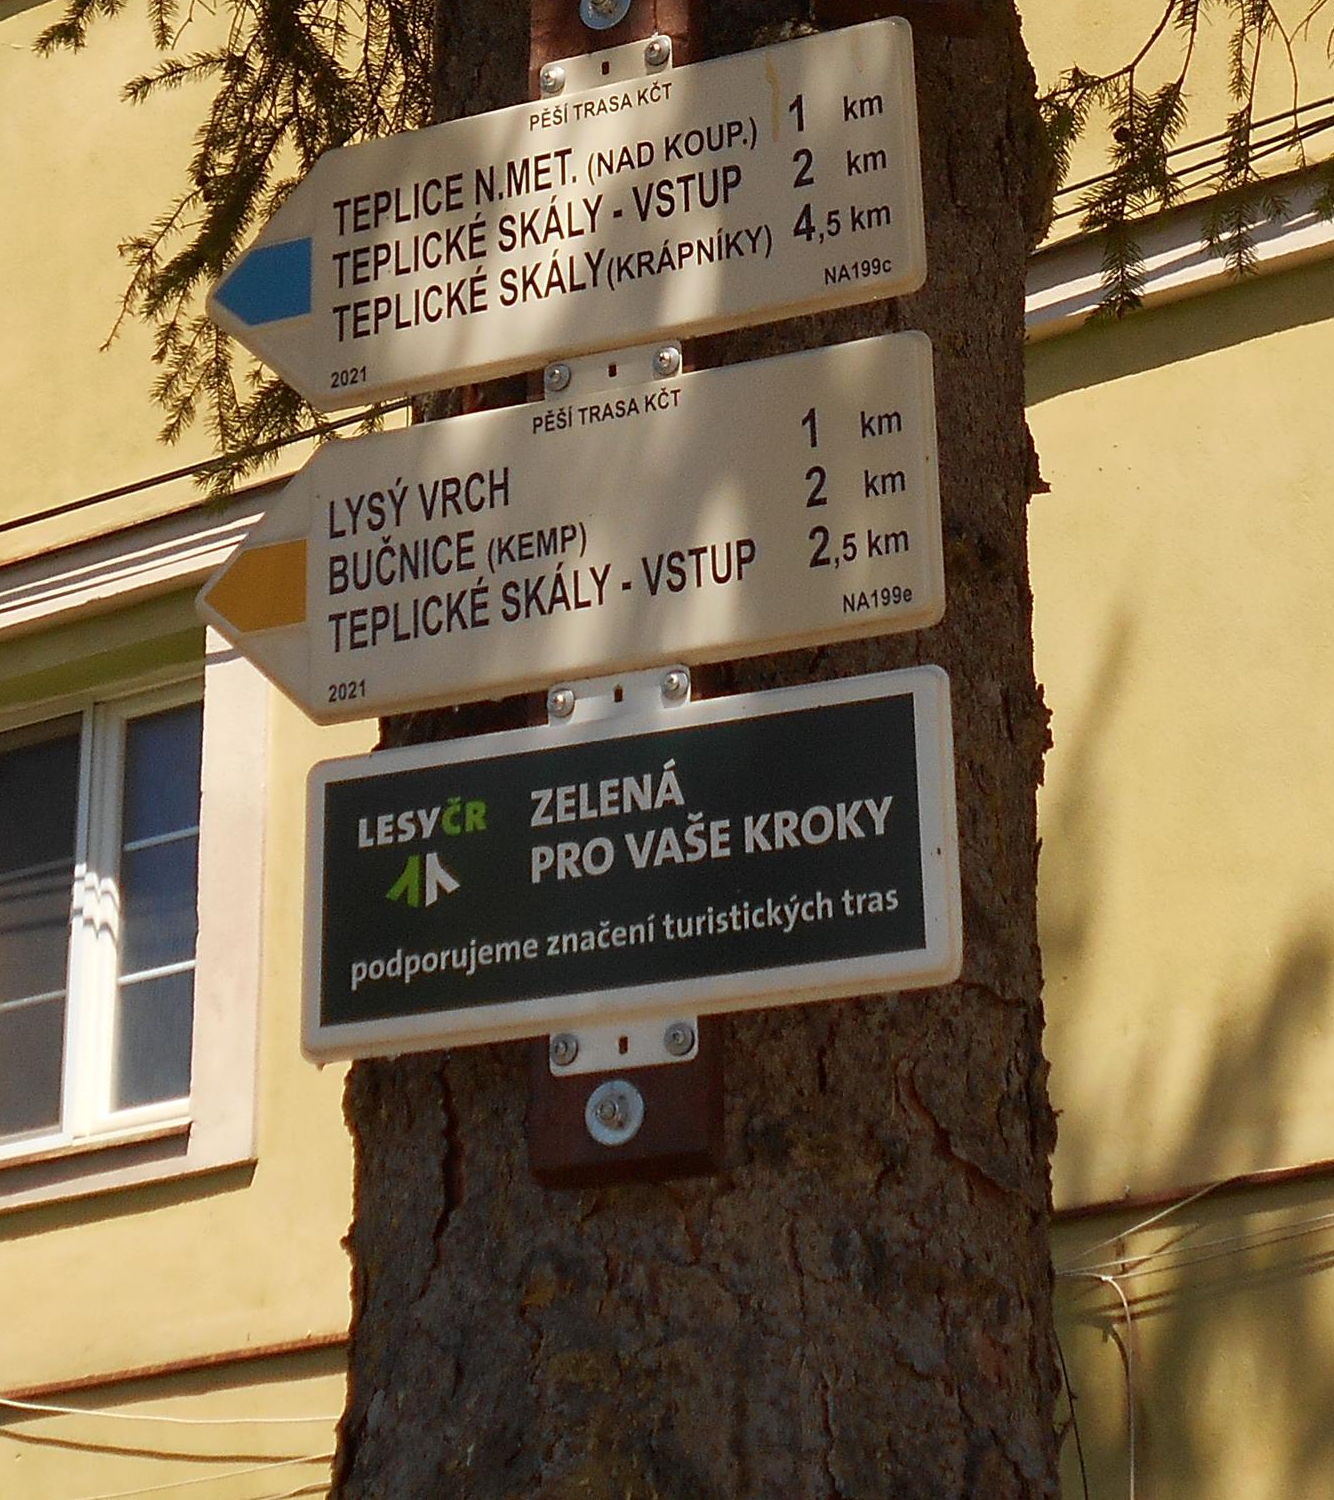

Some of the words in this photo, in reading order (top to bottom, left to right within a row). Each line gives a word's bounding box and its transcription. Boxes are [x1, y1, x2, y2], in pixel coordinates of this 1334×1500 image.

[529, 106, 568, 132] PĚŠÍ
[573, 92, 633, 121] TRASA
[637, 81, 673, 107] KČT
[332, 172, 464, 236] TEPLICE
[588, 141, 655, 186] (NAD
[664, 116, 758, 162] KOUP.)
[788, 93, 805, 132] 1
[843, 93, 884, 122] km
[332, 211, 487, 289] TEPLICKÉ
[498, 194, 604, 253] SKÁLY
[632, 164, 742, 222] VSTUP
[793, 148, 815, 188] 2
[846, 149, 888, 176] km
[332, 265, 489, 343] TEPLICKÉ
[793, 203, 841, 245] 4,5
[850, 204, 892, 232] km
[824, 257, 893, 285] NA199c
[330, 365, 368, 389] 2021
[532, 407, 573, 435] PĚŠÍ
[578, 398, 640, 427] TRASA
[644, 388, 682, 413] KČT
[328, 476, 409, 540] LYSÝ
[418, 467, 510, 521] VRCH
[801, 407, 818, 448] 1
[860, 410, 903, 438] km
[328, 530, 476, 596] BUČNICE
[487, 521, 588, 574] (KEMP)
[805, 465, 828, 508] 2
[864, 469, 907, 498] km
[328, 576, 490, 653] TEPLICKÉ
[501, 561, 612, 622] SKÁLY
[641, 538, 757, 597] VSTUP
[809, 525, 858, 569] 2,5
[867, 528, 910, 558] km
[842, 586, 914, 614] NA199e
[328, 679, 367, 703] 2021
[530, 757, 686, 828] ZELENÁ
[530, 836, 616, 885] PRO
[624, 811, 732, 870] VAŠE
[743, 795, 894, 854] KROKY
[350, 936, 539, 991] podporujeme
[546, 913, 656, 957] značení
[662, 890, 834, 941] turistických
[841, 888, 900, 918] tras
